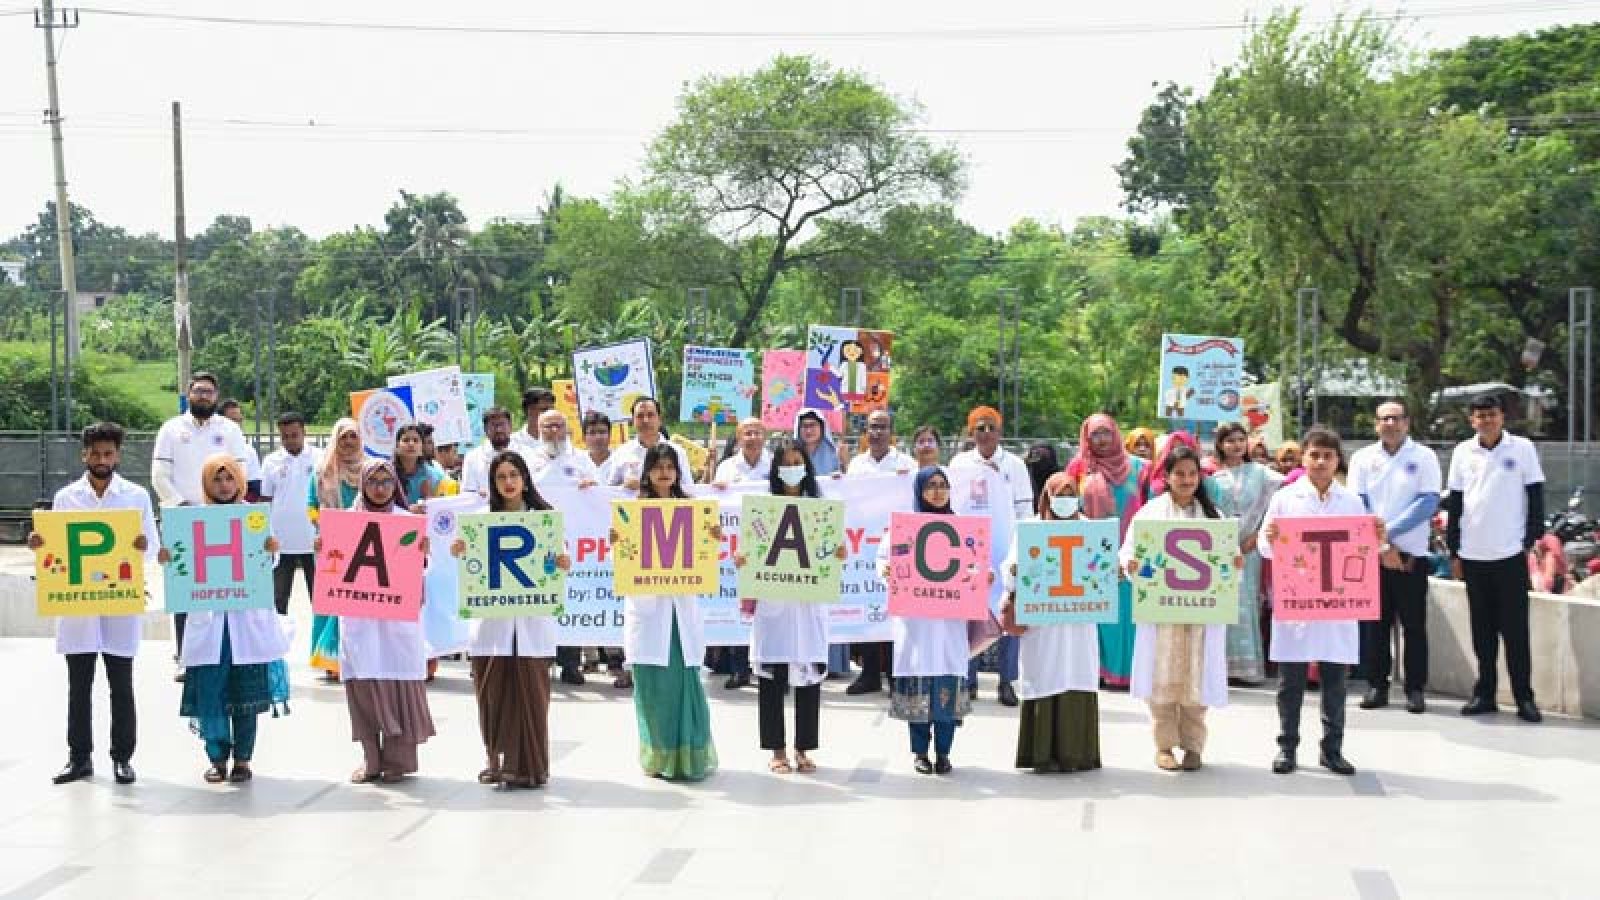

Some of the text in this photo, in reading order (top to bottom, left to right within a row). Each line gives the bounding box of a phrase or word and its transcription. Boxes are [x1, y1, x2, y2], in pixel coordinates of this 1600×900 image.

[67, 522, 115, 585] P
[192, 518, 244, 583] H
[343, 522, 389, 587] A
[641, 506, 694, 569] M
[765, 504, 811, 568] A
[915, 521, 960, 582] C
[487, 526, 536, 590] R
[1048, 535, 1085, 596] I
[1165, 529, 1212, 591] S
[1301, 530, 1349, 592] T
[48, 588, 140, 602] PROFESSIONAL
[192, 588, 248, 600] HOPEFUL
[327, 588, 402, 605] ATTENTIVE
[633, 575, 703, 585] MOTIVATED
[756, 572, 818, 585] ACCURATE
[913, 587, 960, 600] CARING
[467, 593, 558, 607] RESPONSIBLE
[1024, 601, 1109, 614] INTELLIGENT
[1160, 596, 1217, 608] SKILLED
[1283, 598, 1372, 610] TRUSTWORTHY
